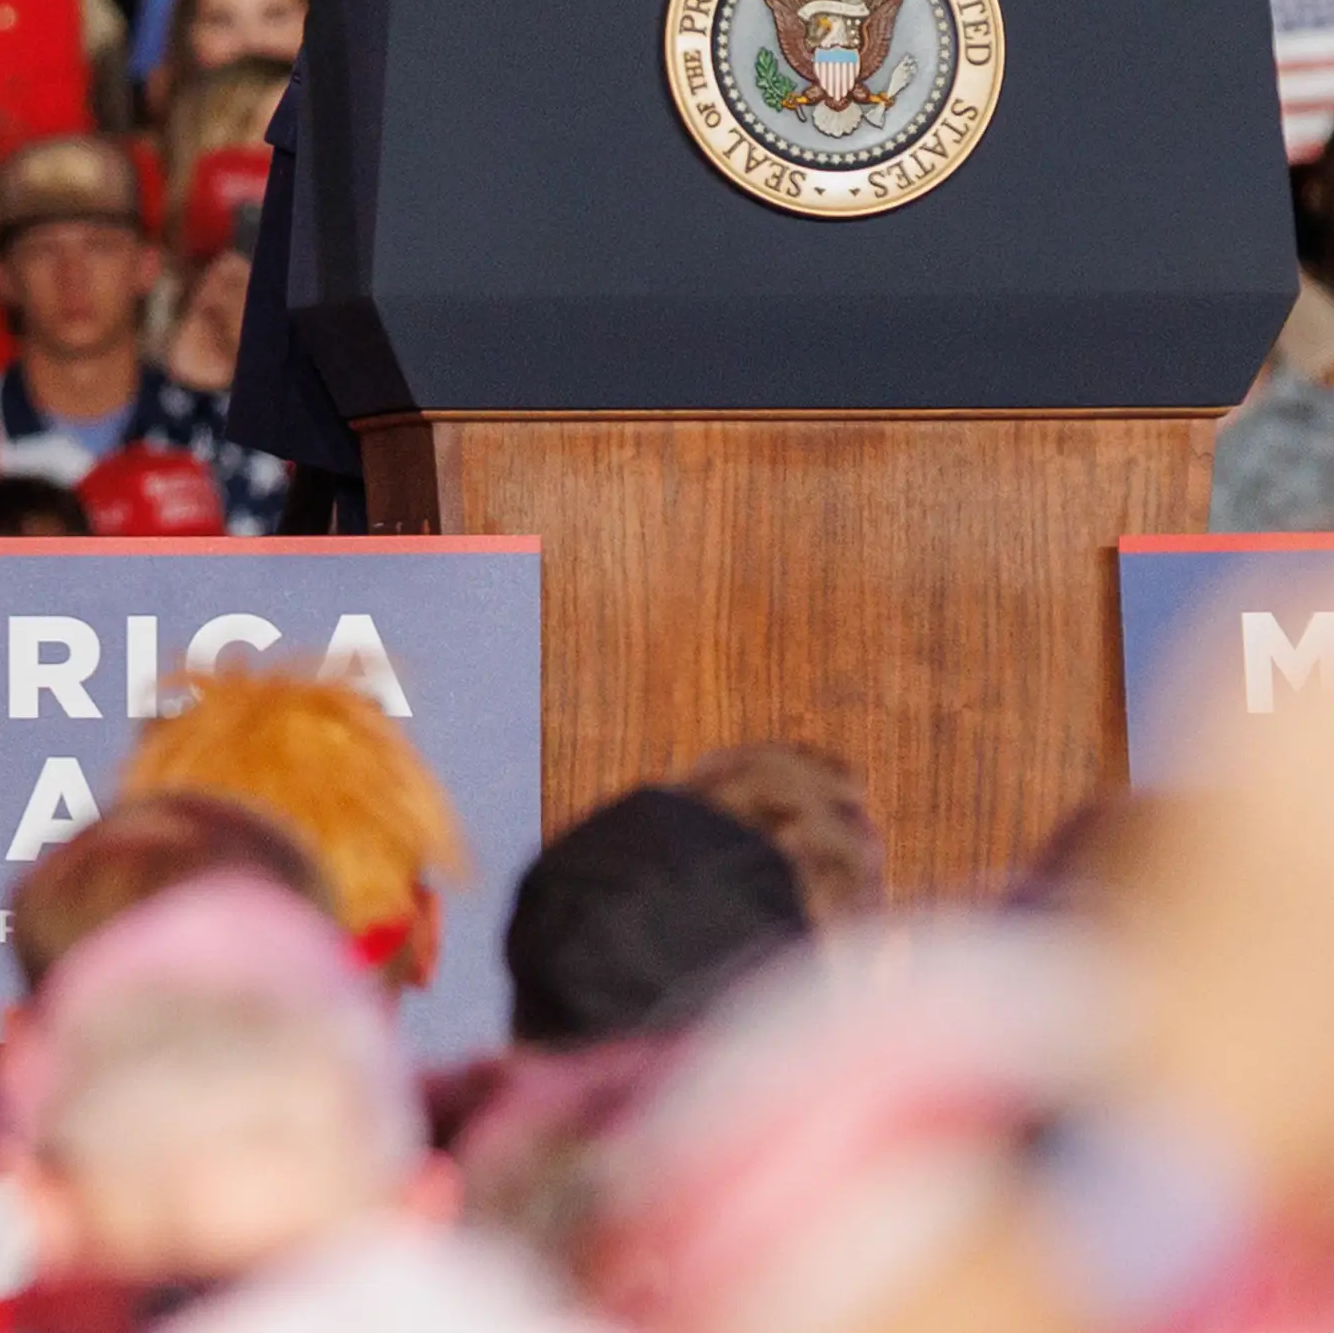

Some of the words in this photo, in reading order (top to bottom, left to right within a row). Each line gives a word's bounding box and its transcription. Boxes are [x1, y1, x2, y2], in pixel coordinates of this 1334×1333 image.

[683, 50, 708, 96] THE
[696, 102, 722, 128] OF
[722, 127, 807, 198] SEAL
[868, 98, 979, 198] STATES
